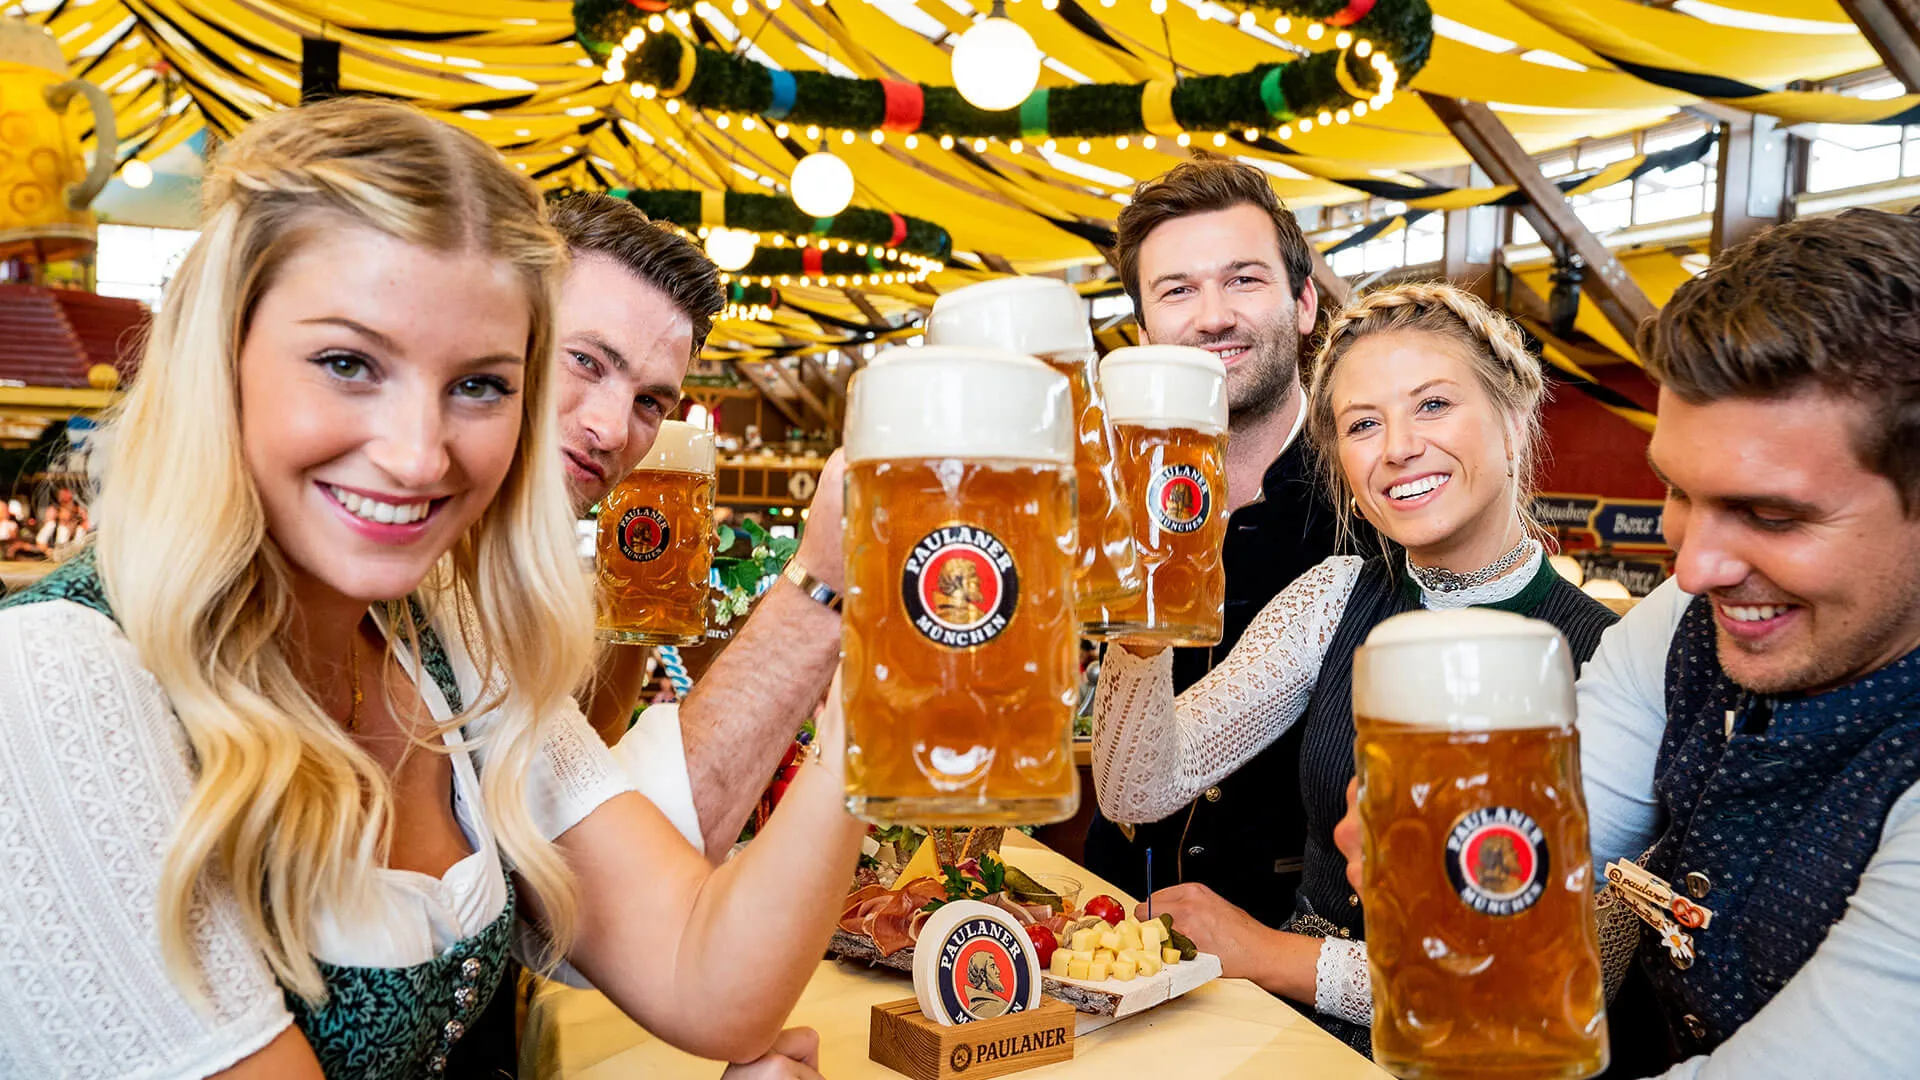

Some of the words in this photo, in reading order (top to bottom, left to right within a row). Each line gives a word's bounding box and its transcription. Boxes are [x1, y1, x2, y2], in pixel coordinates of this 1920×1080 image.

[620, 508, 667, 530] PAULANER
[905, 526, 1013, 574] PAULANER
[1447, 806, 1543, 852] PAULANER
[941, 921, 1021, 970] PAULANER
[976, 1027, 1066, 1063] PAULANER
